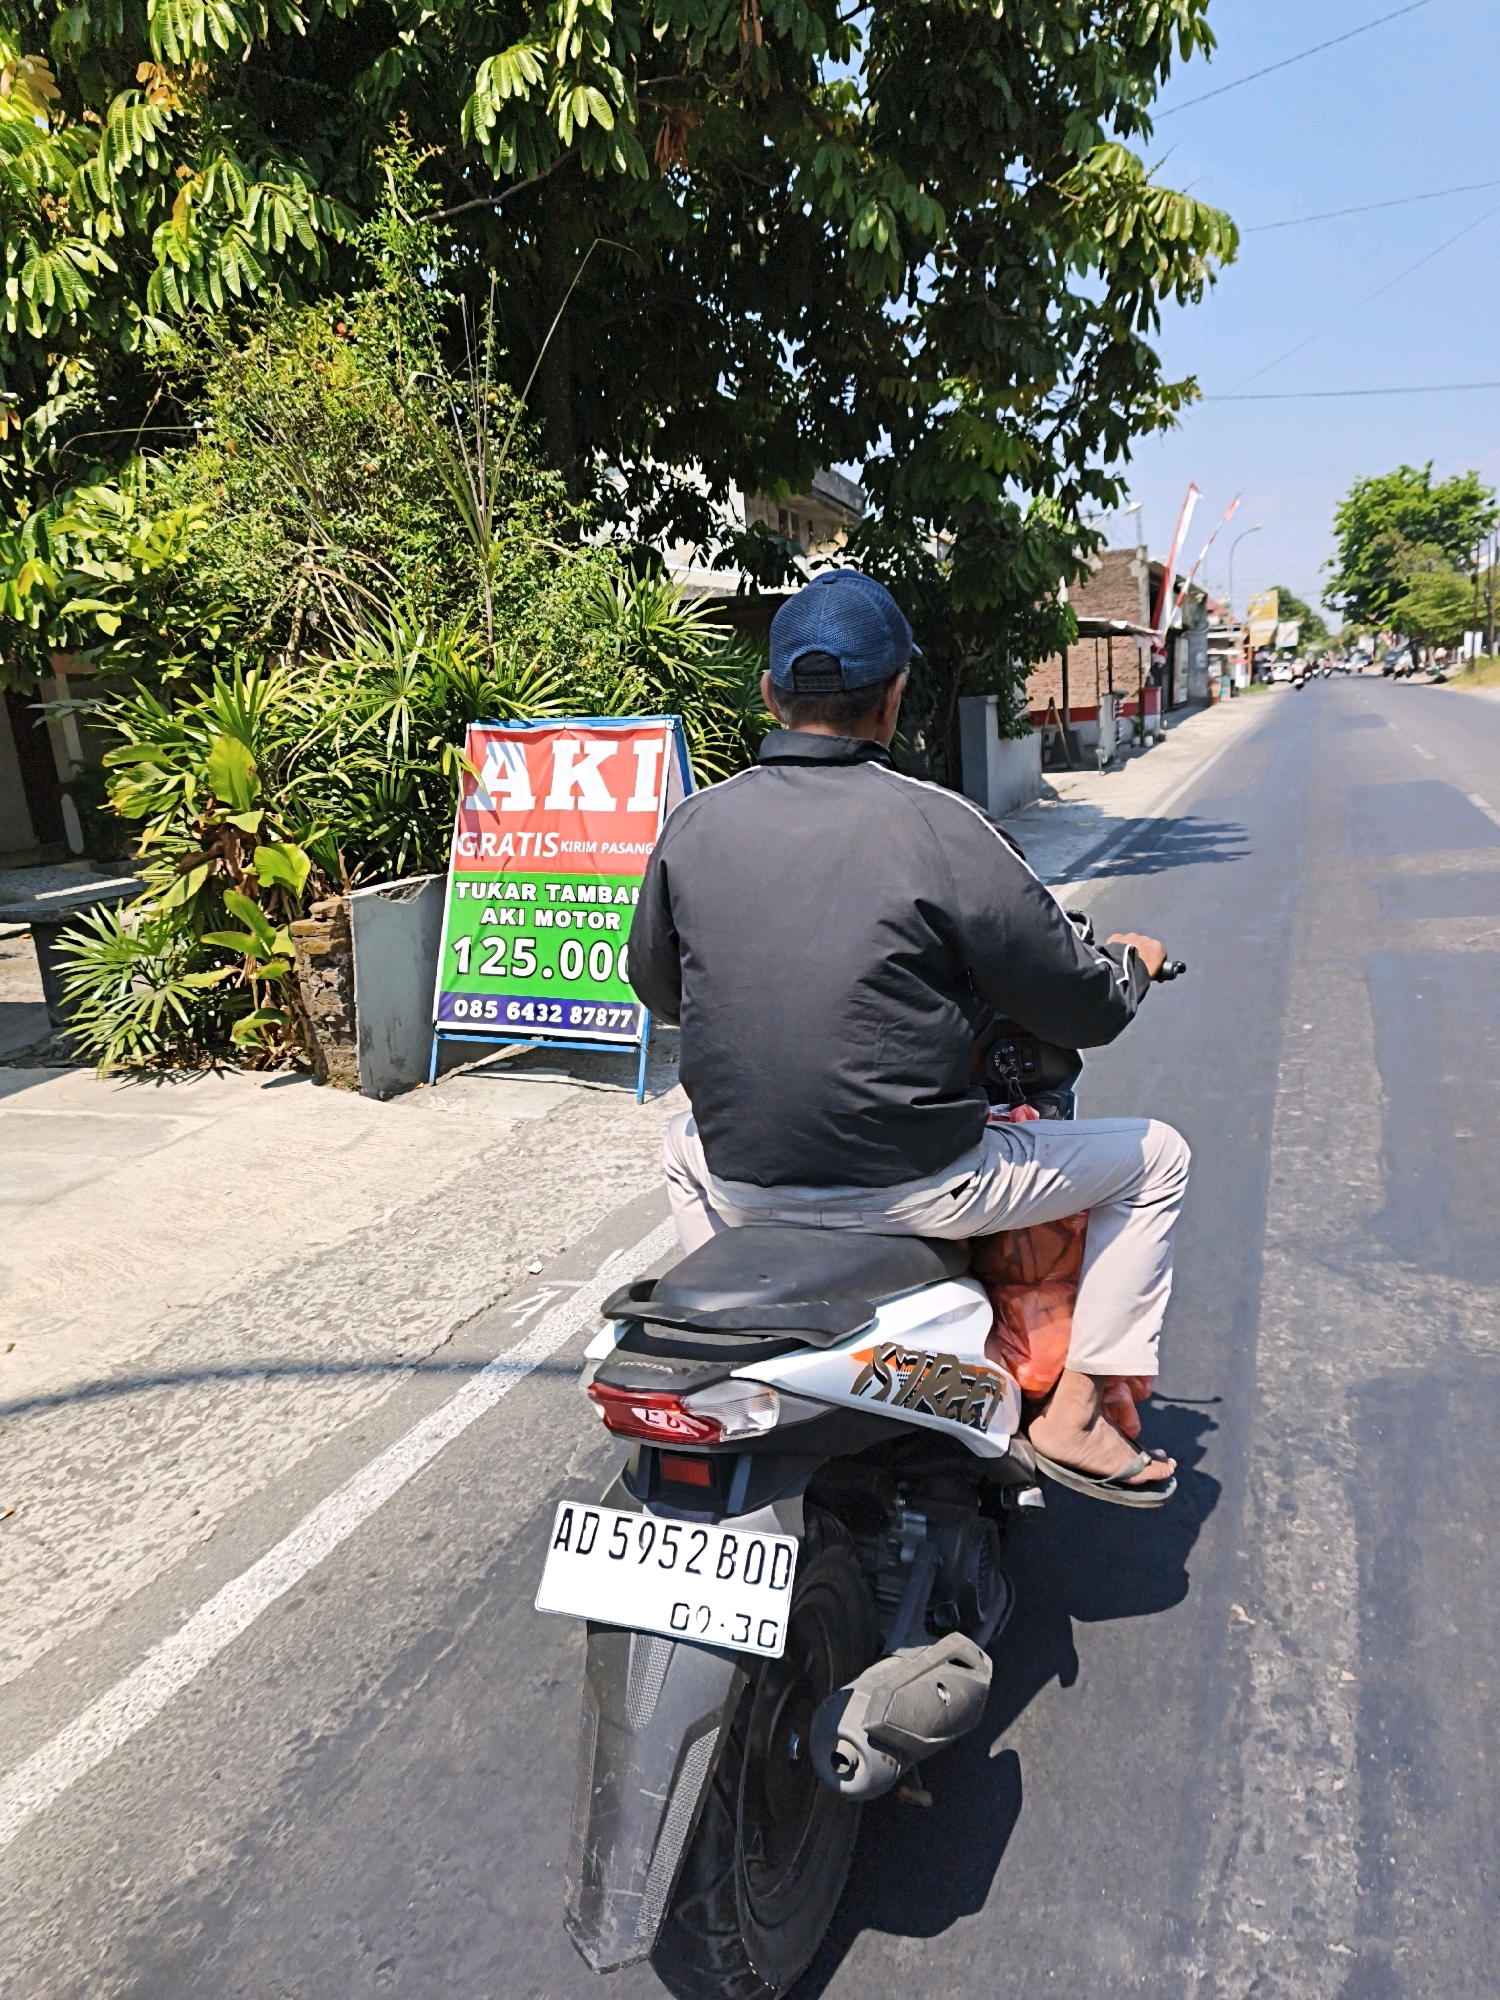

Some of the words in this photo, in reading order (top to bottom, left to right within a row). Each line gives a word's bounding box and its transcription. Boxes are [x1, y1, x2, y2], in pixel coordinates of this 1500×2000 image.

[465, 739, 664, 812] AKI
[457, 831, 560, 857] GRATIS
[560, 840, 597, 853] KIRIM
[601, 842, 653, 855] PASANG
[455, 881, 537, 901] TUKAR
[480, 907, 525, 926] AKI
[535, 909, 621, 931] MOTOR
[454, 999, 498, 1019] 085
[507, 1002, 562, 1023] 6432
[570, 1006, 633, 1028] 87877
[617, 1361, 673, 1373] HONDA
[850, 1341, 1002, 1434] STREET
[553, 1508, 600, 1555] AD
[608, 1516, 708, 1575] 5952
[716, 1534, 793, 1590] BOD
